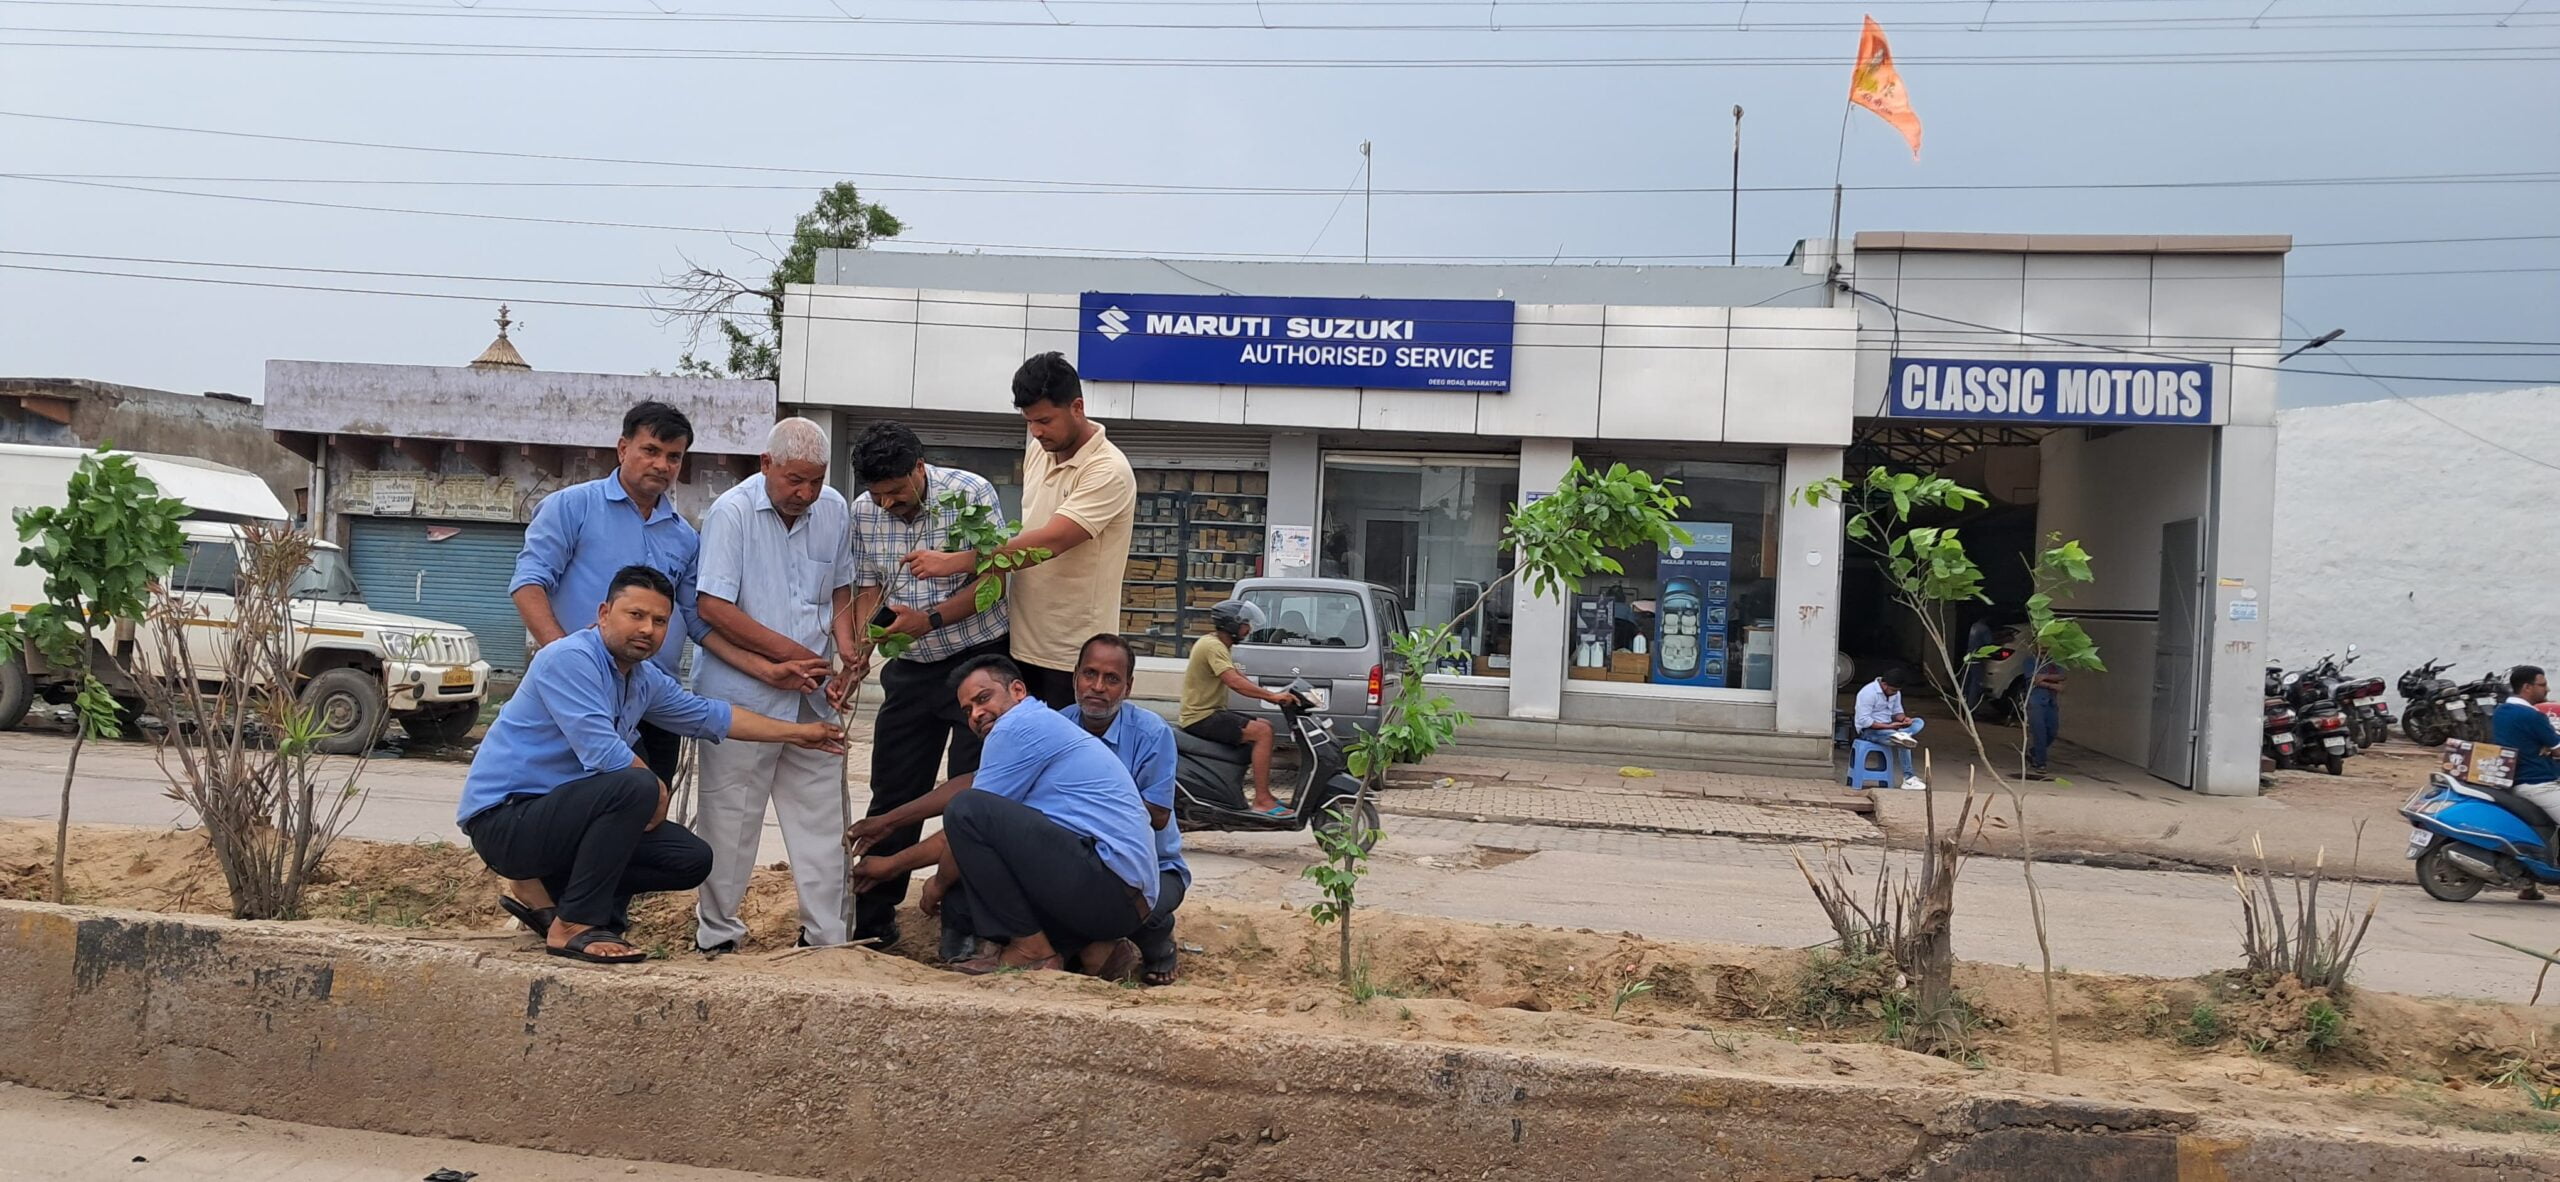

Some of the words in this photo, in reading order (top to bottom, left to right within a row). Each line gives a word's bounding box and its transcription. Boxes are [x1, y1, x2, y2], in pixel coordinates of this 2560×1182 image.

[1146, 314, 1270, 338] MARUTI
[1286, 317, 1414, 340] SUZUKI
[1240, 343, 1386, 366] AUTHORISED
[1395, 347, 1495, 369] SERVICE
[1467, 379, 1507, 387] BHARATPUR
[1901, 364, 2045, 414] CLASSIC
[2057, 368, 2202, 417] MOTORS
